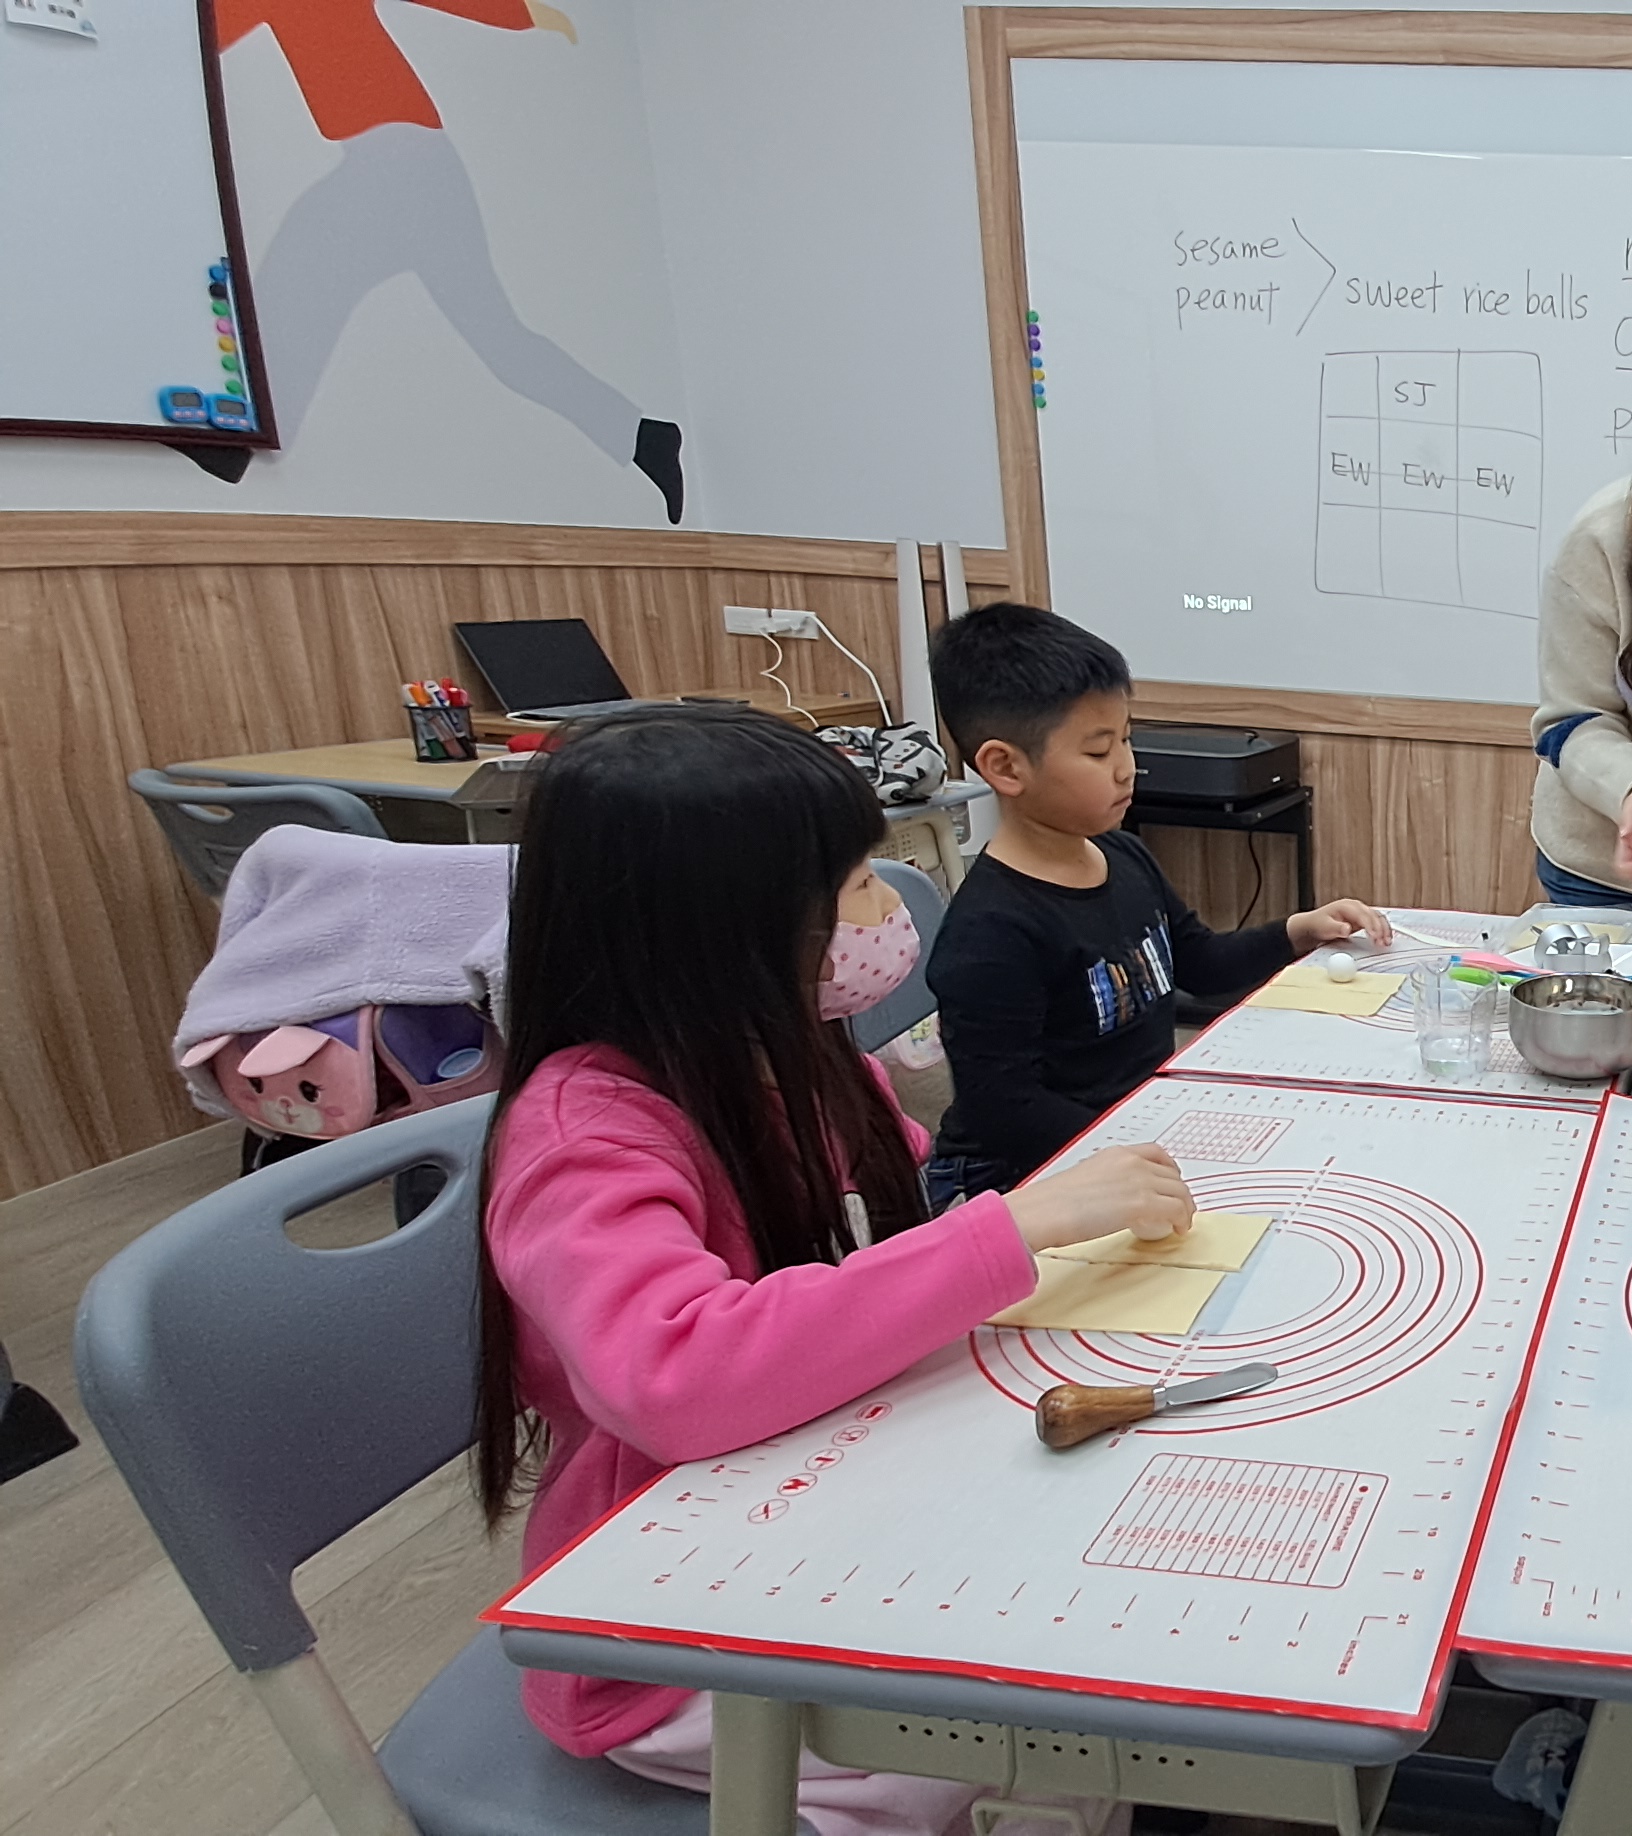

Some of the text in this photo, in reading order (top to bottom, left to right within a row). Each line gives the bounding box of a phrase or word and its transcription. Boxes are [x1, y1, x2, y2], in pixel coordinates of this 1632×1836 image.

[1176, 281, 1281, 331] peanut
[1346, 268, 1590, 321] sweet rice balls
[1331, 452, 1371, 486] EW
[1476, 467, 1515, 498] EW
[1183, 593, 1253, 614] No Signal
